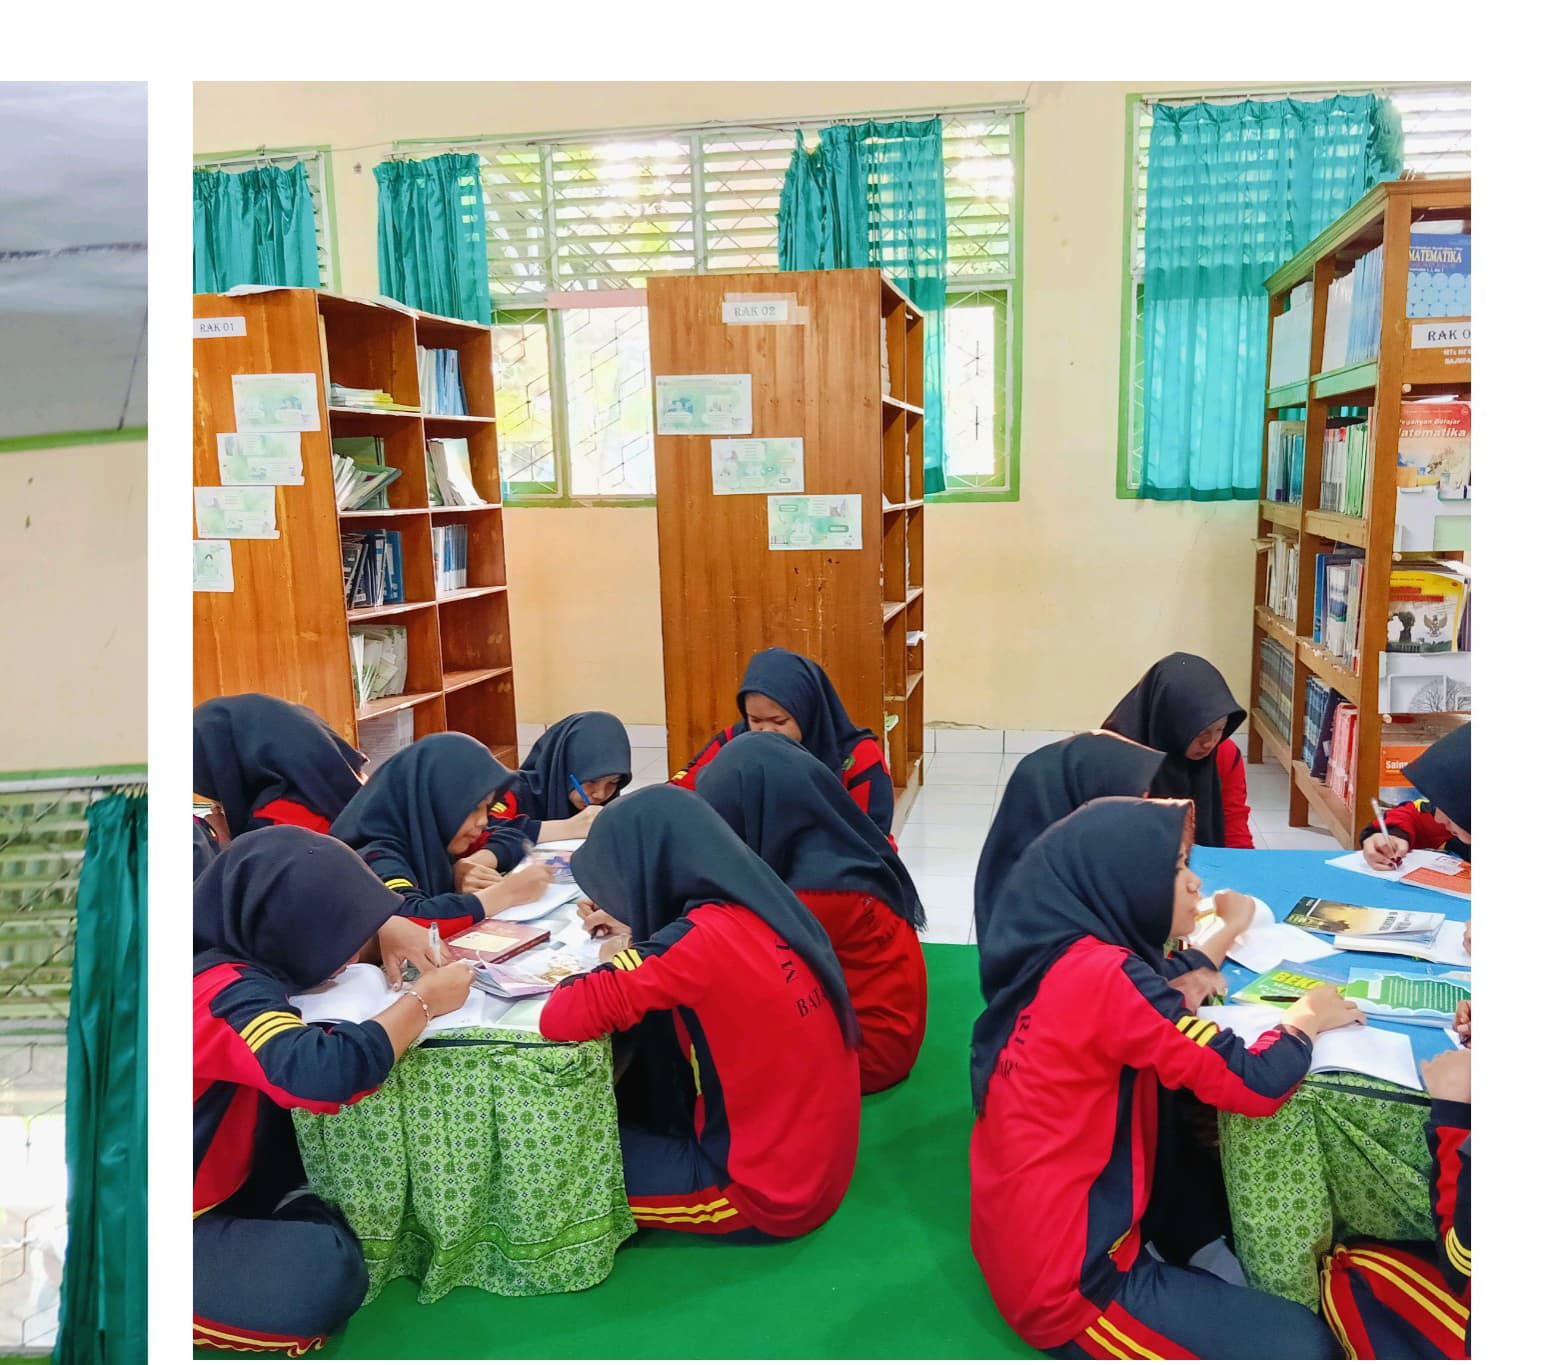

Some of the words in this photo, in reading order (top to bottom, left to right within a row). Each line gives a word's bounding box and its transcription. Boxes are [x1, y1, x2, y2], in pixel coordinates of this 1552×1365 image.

[733, 306, 759, 317] RAK
[762, 305, 776, 317] 02
[200, 323, 221, 333] RAK
[1427, 329, 1457, 341] RAK
[1399, 427, 1466, 439] atematika
